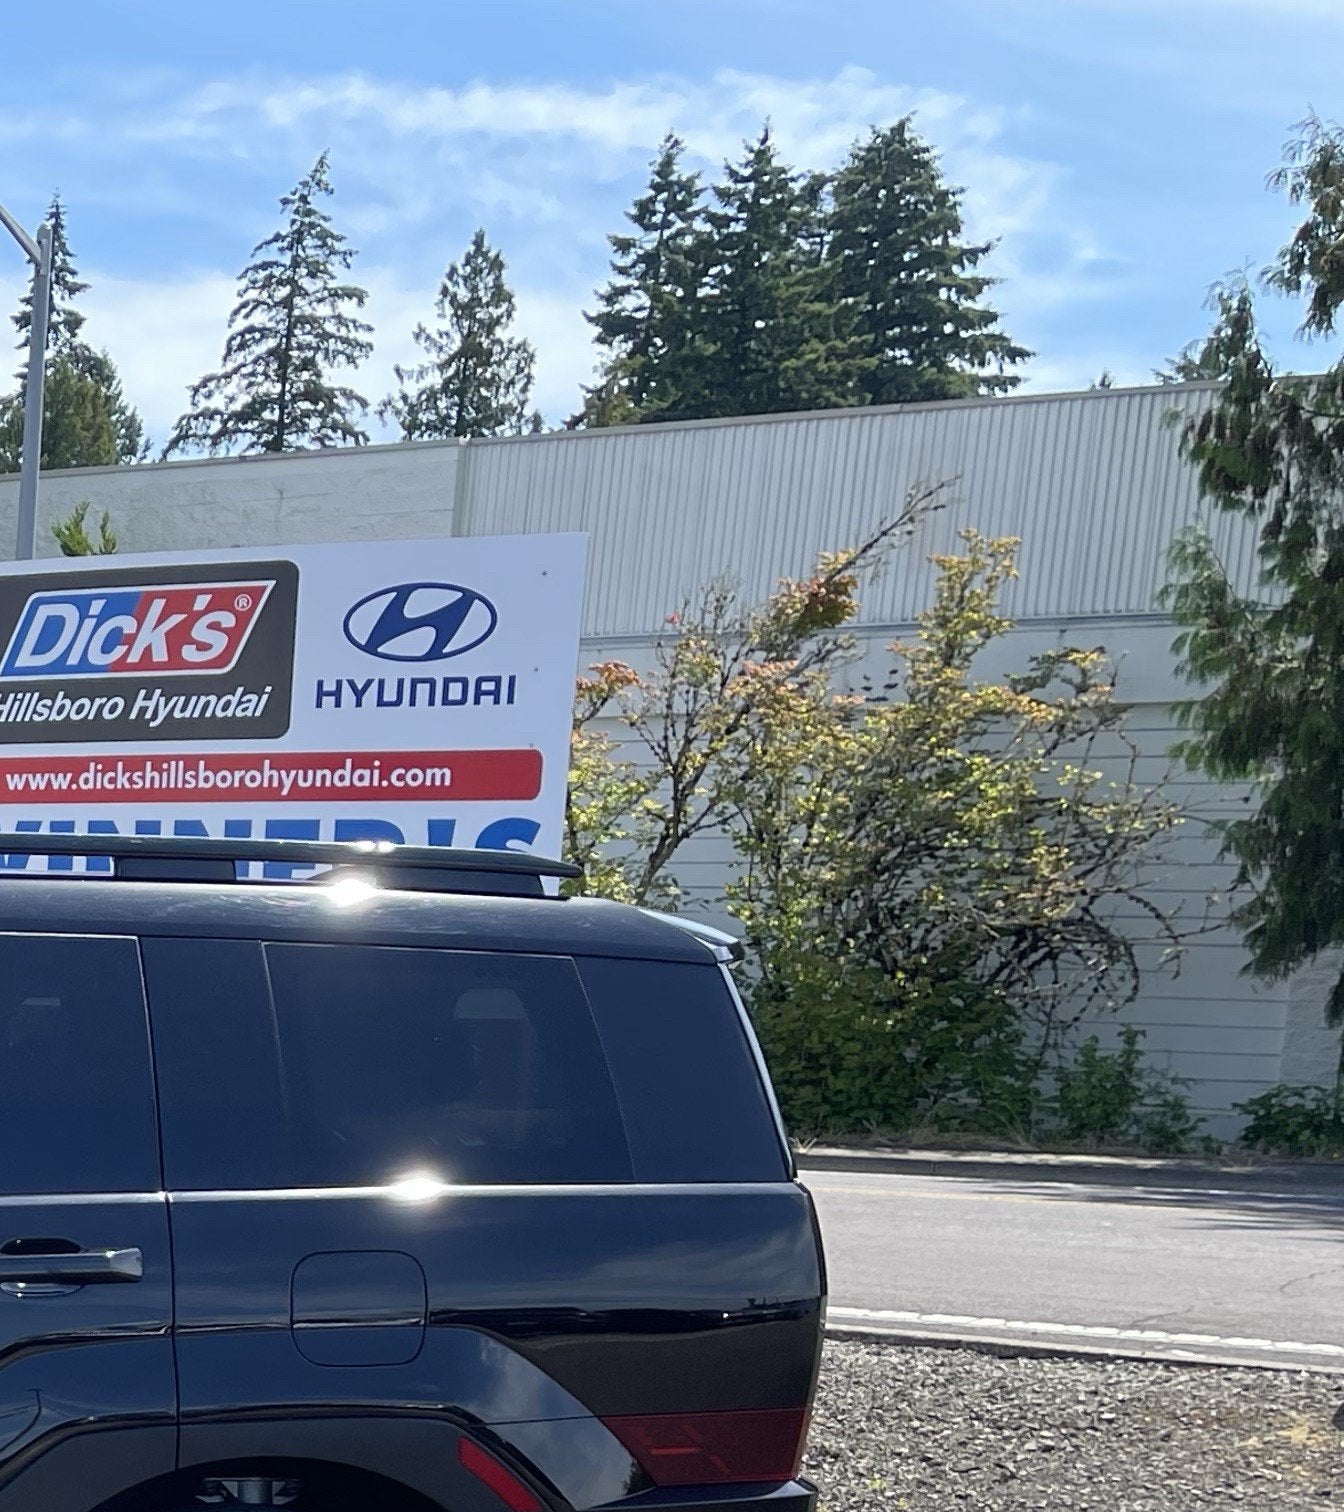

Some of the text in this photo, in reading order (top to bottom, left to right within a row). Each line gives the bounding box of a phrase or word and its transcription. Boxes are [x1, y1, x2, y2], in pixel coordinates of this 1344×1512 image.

[14, 594, 236, 668] Dick's
[129, 686, 272, 727] Hyundai
[315, 675, 516, 708] HYUNDAI
[5, 759, 451, 795] www.dickshillsborohyundai.com
